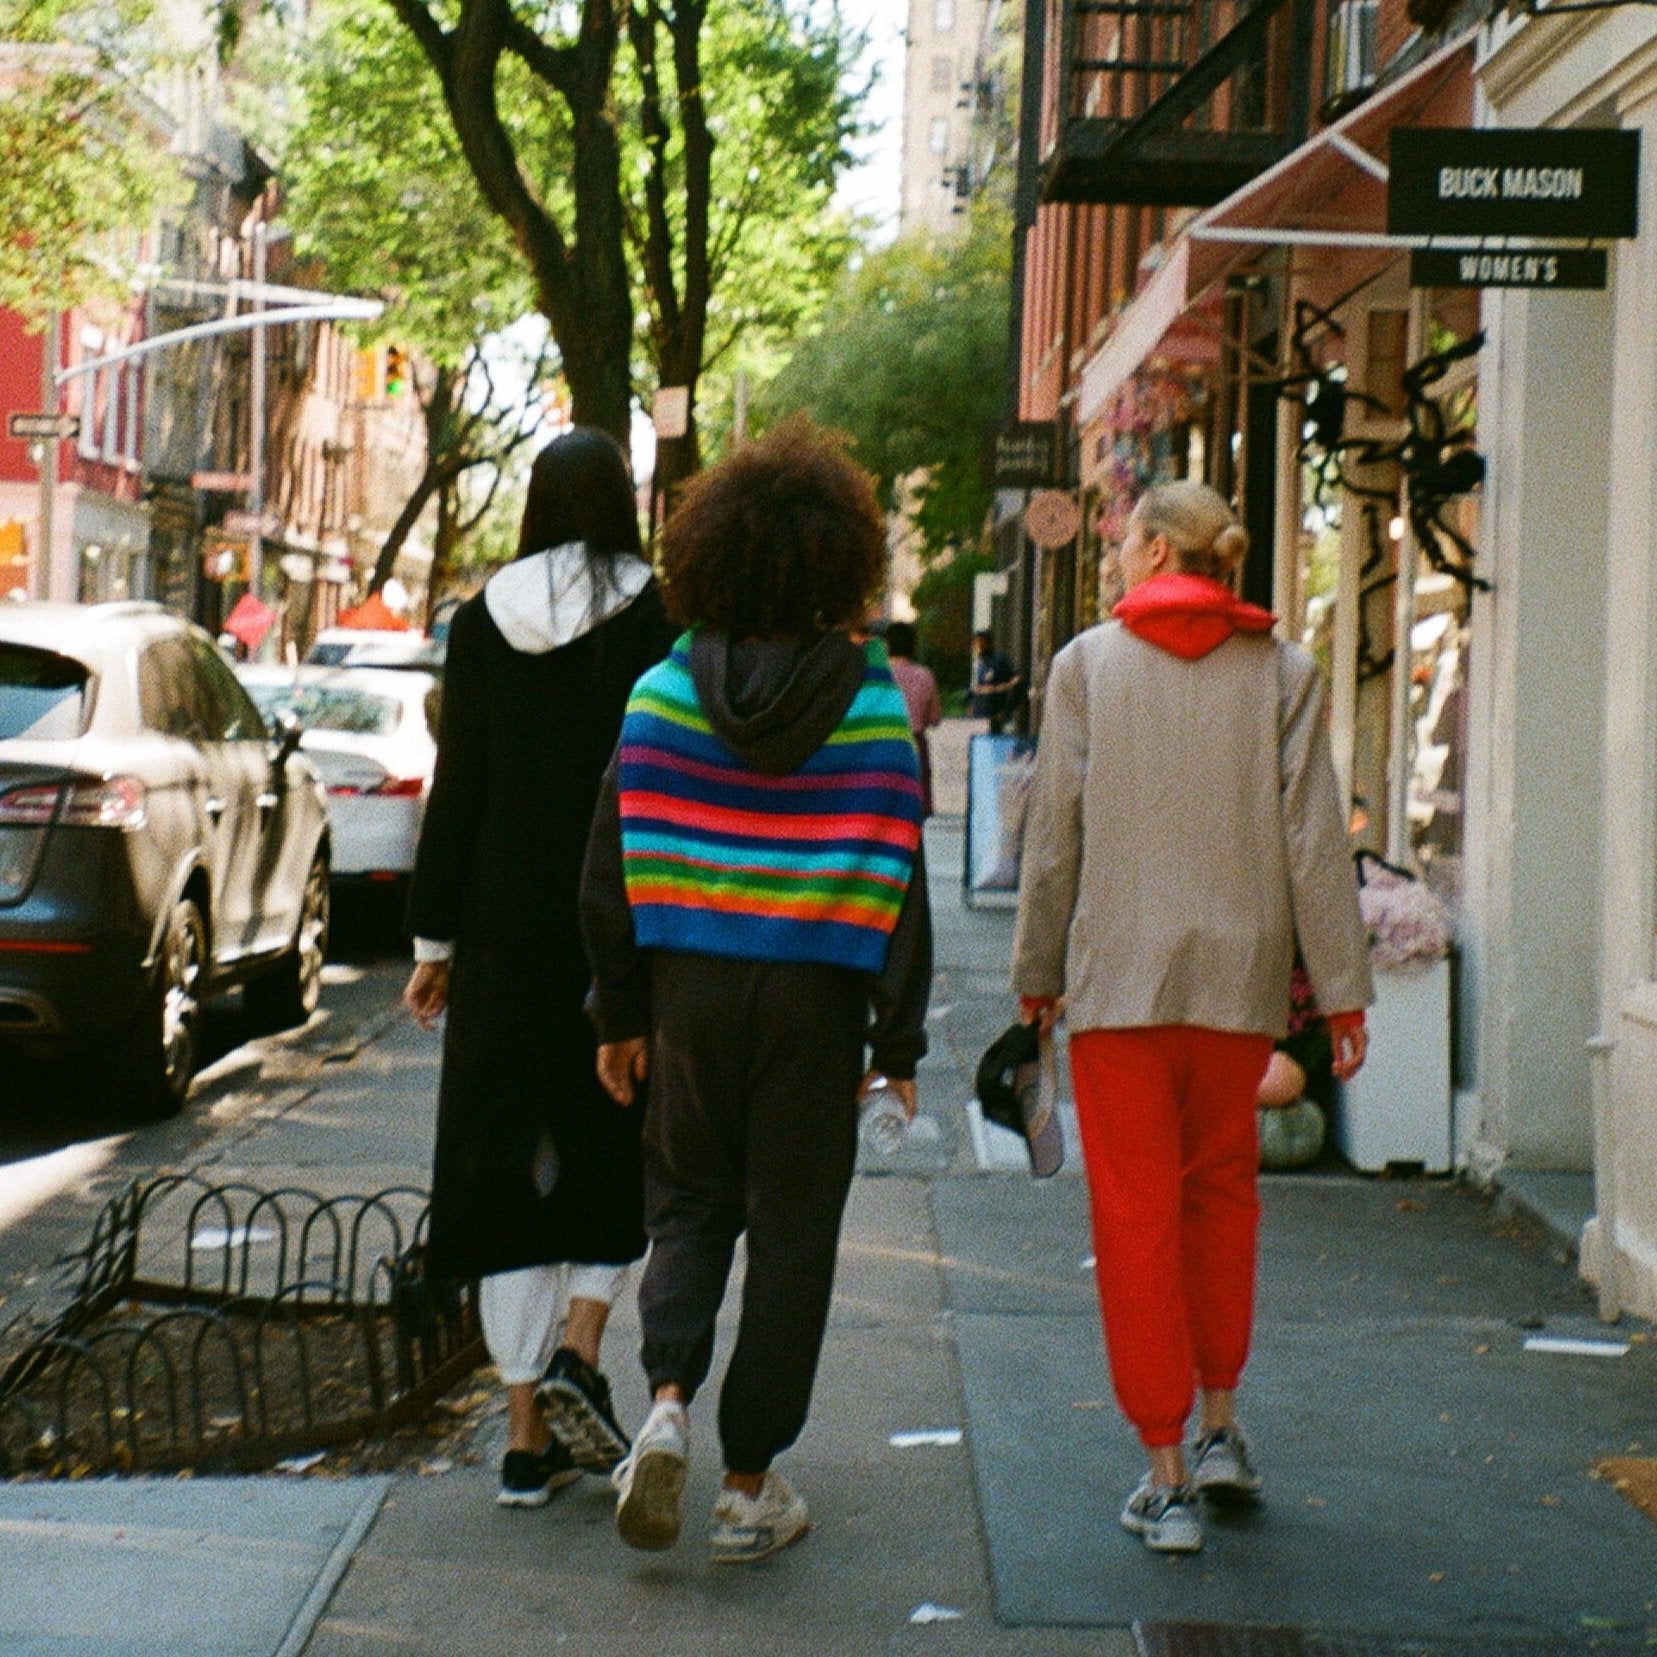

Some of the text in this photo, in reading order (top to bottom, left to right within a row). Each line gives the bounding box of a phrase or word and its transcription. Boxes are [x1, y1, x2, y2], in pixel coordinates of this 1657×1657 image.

[1439, 167, 1583, 199] BUCK MASON
[1459, 256, 1558, 282] WOMEN'S
